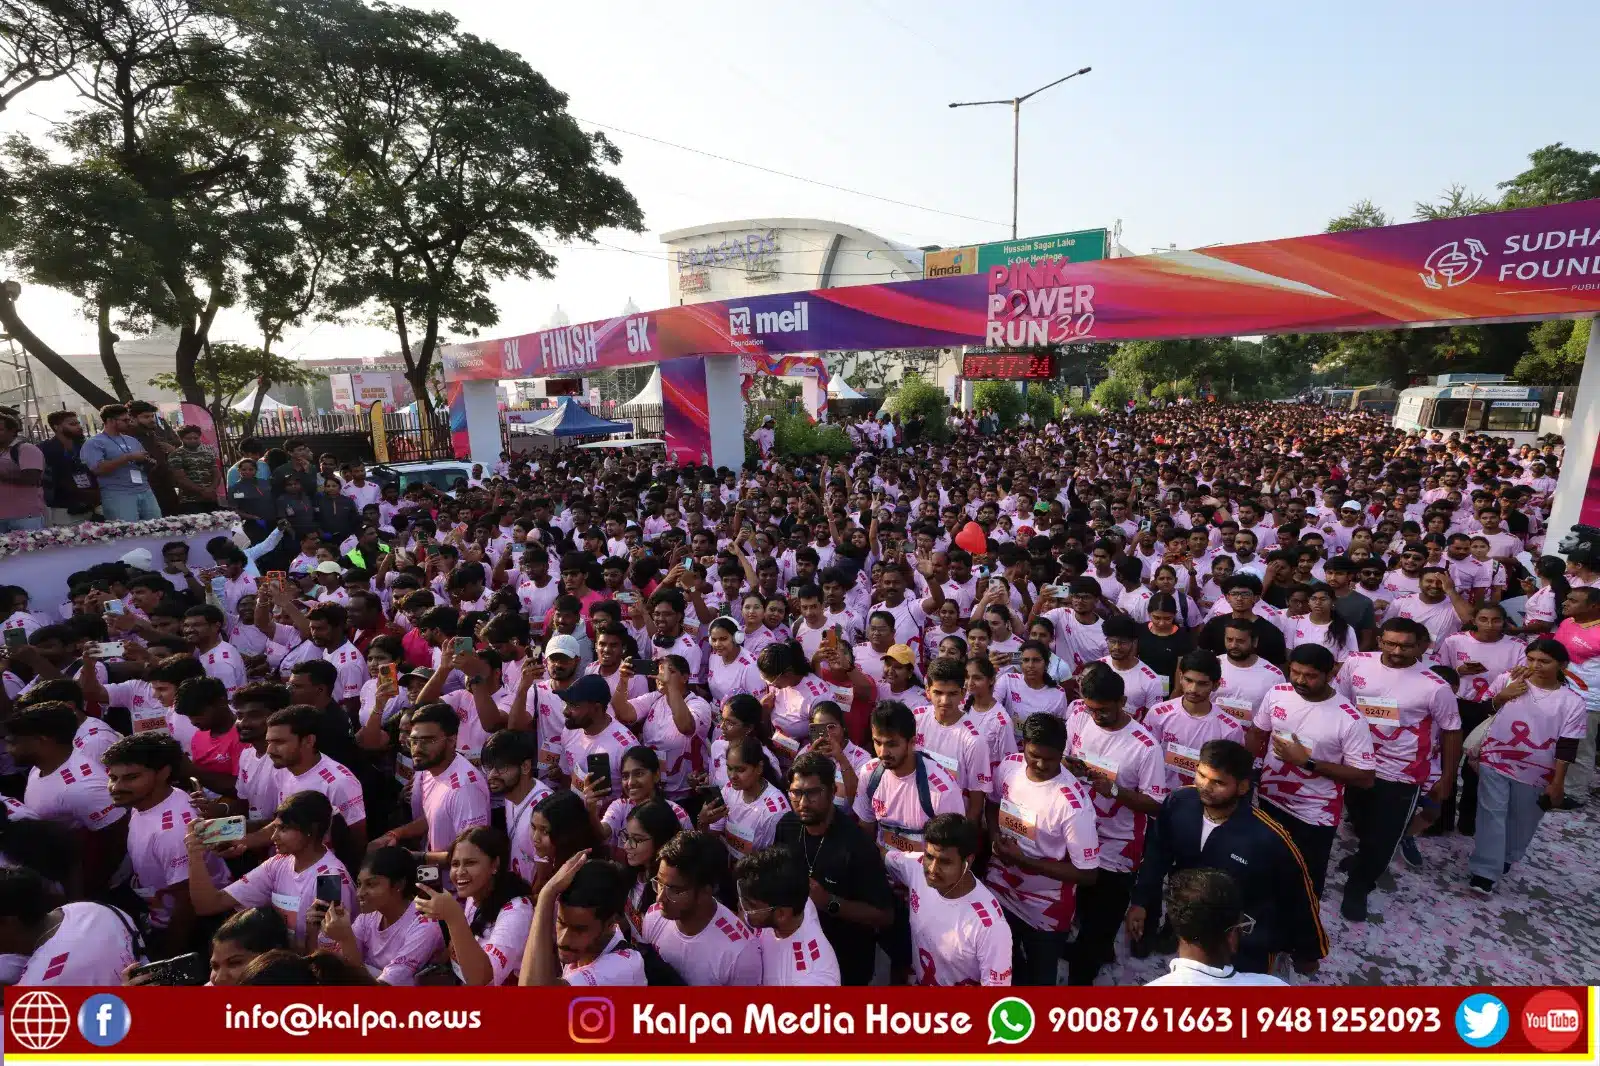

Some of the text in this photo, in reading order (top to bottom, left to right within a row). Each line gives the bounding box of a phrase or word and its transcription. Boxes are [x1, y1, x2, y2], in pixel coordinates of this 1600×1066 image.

[1003, 238, 1076, 254] Hussain Sagar Lake
[1015, 256, 1029, 264] Our
[989, 257, 1070, 293] PINK
[756, 301, 809, 334] meil
[988, 284, 1095, 321] POWER
[540, 323, 598, 369] FINISH
[626, 316, 652, 354] 5K
[730, 339, 764, 347] Foundation
[986, 312, 1096, 347] RUN 3.0
[504, 338, 523, 371] 3K
[1365, 707, 1391, 717] 52477
[1173, 757, 1200, 769] 5545
